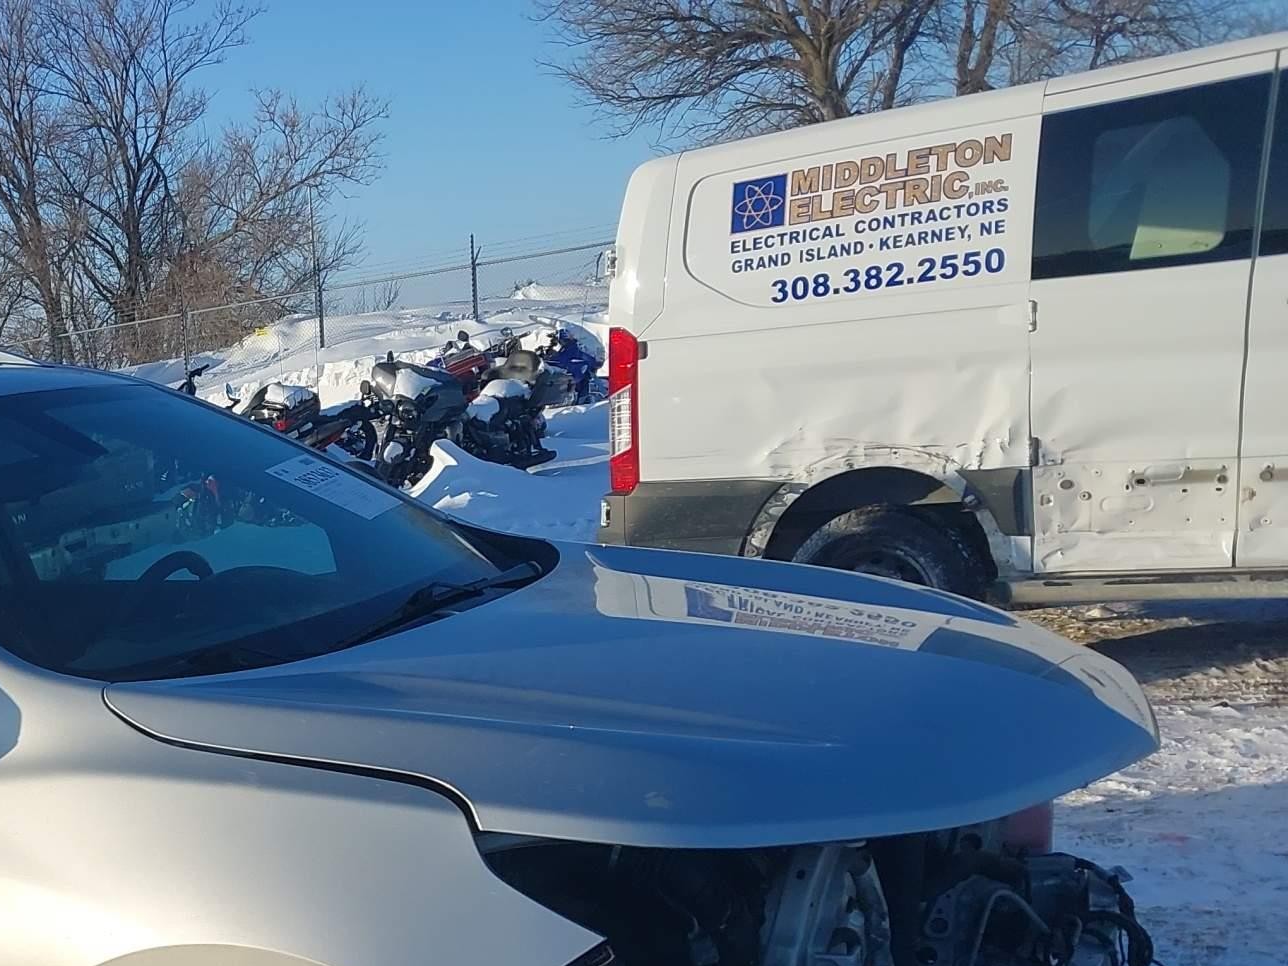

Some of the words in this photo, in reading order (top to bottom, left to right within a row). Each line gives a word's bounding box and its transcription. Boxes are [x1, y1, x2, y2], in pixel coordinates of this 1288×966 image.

[790, 133, 1013, 197] MIDDLETON
[975, 178, 1010, 196] INC.
[730, 223, 846, 254] ELECTRICAL
[854, 198, 1009, 233] CONTRACTORS
[731, 252, 791, 274] GRAND
[799, 241, 864, 264] ISLAND
[879, 224, 972, 251] KEARNEY,
[980, 219, 1006, 237] NE
[770, 247, 1006, 303] 308.382.2550
